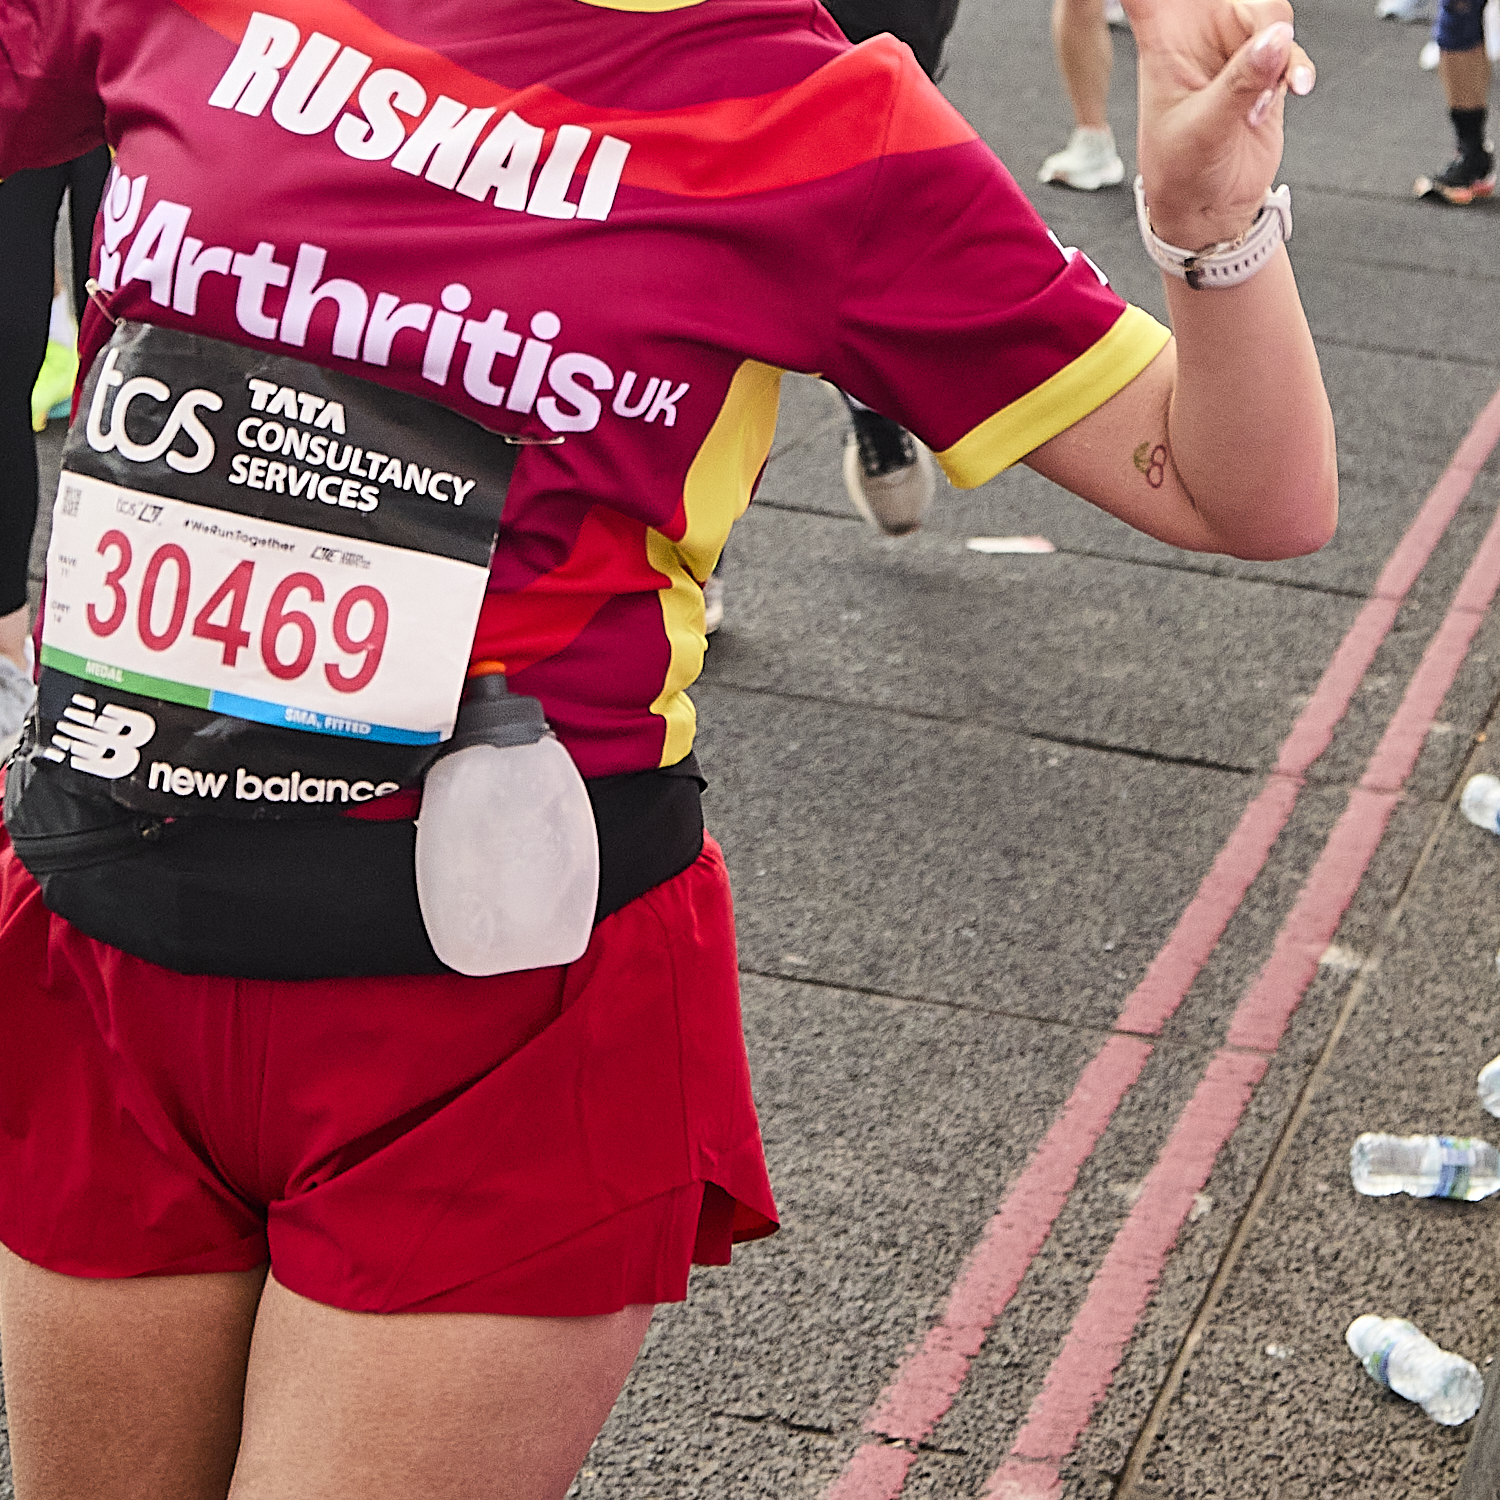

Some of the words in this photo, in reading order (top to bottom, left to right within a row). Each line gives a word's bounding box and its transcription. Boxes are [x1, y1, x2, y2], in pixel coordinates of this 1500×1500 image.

[122, 200, 615, 434] Arthritis
[612, 370, 690, 429] UK
[85, 348, 223, 474] tcs
[248, 378, 346, 436] TATA
[227, 454, 380, 513] SERVICES
[236, 416, 476, 507] CONSULTANCY
[86, 528, 390, 694] 30469
[85, 659, 124, 684] MEDAL
[324, 715, 373, 736] FITTED
[148, 760, 229, 799] new
[234, 767, 401, 803] balance
